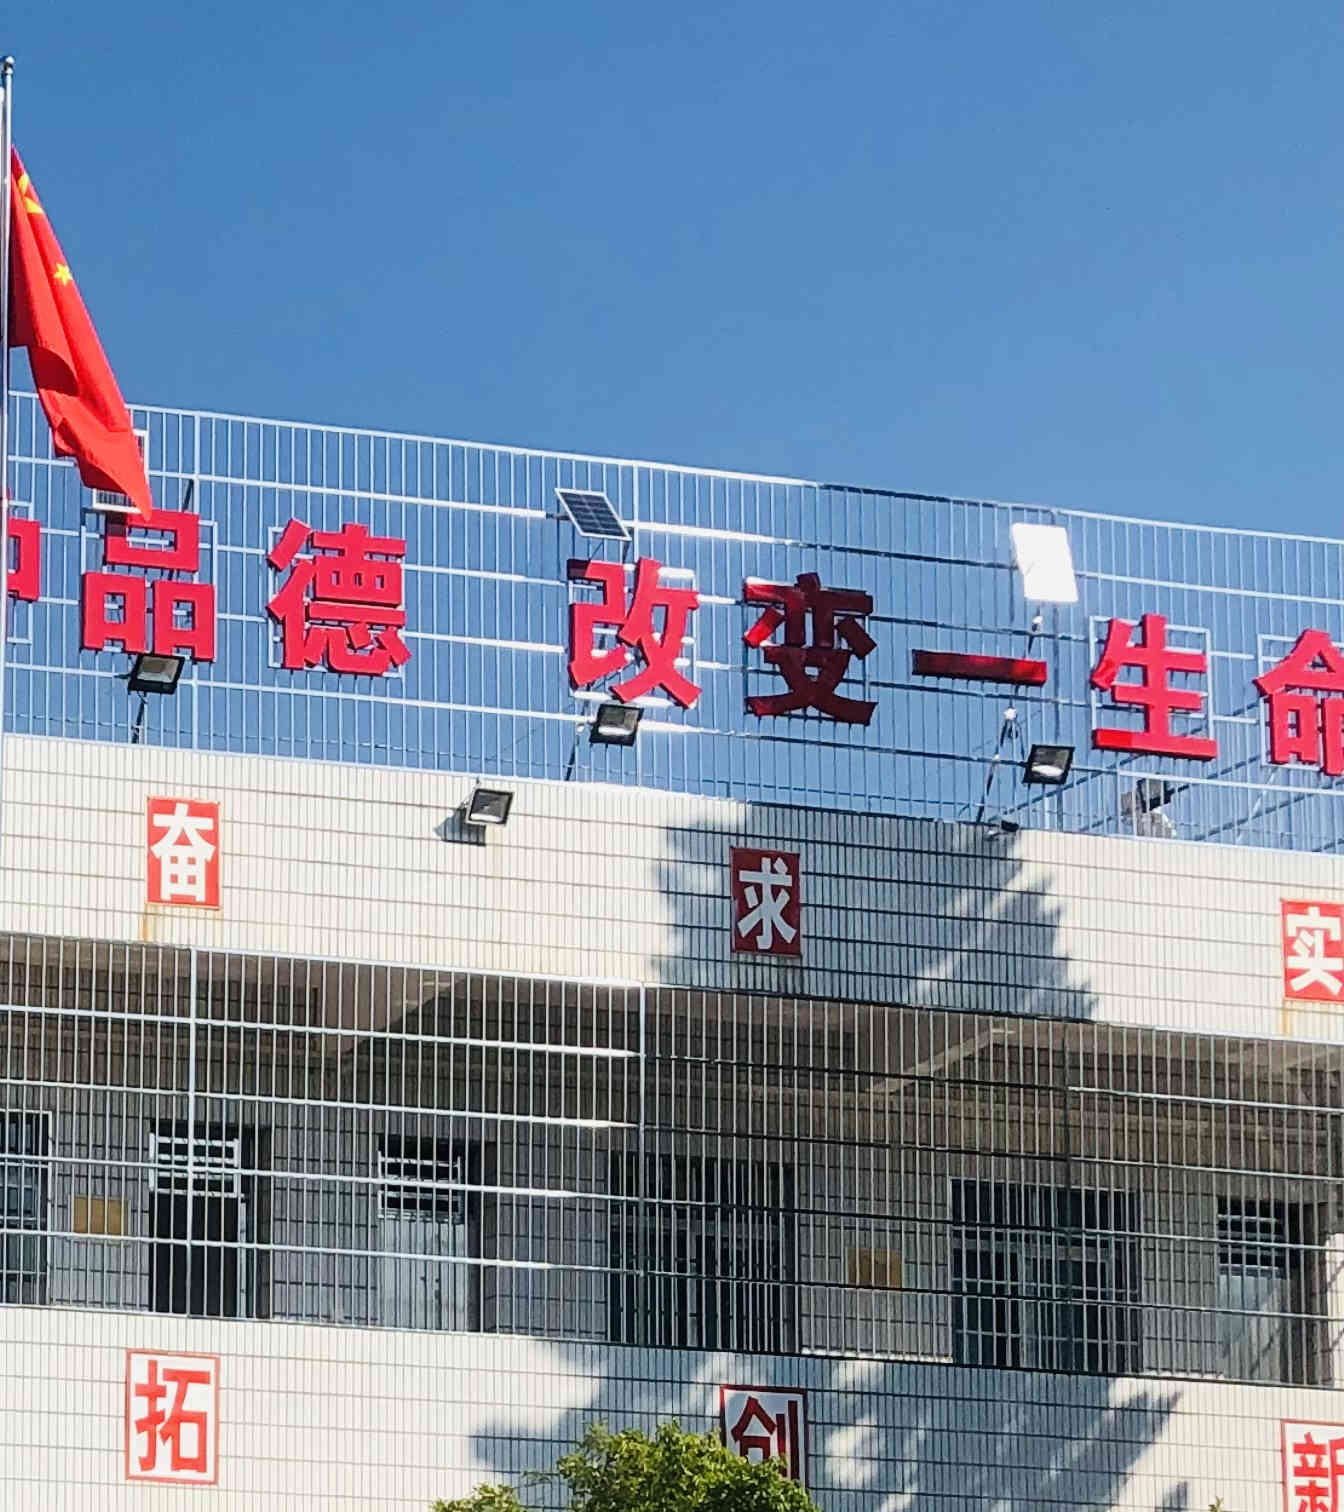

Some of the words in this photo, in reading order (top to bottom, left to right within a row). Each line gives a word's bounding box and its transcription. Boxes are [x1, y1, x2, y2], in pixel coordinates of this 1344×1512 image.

[568, 556, 1344, 777] 改变一生命
[150, 801, 216, 903] 奋
[736, 856, 798, 951] 求
[1286, 906, 1344, 996] 实
[134, 1359, 211, 1474] 拓
